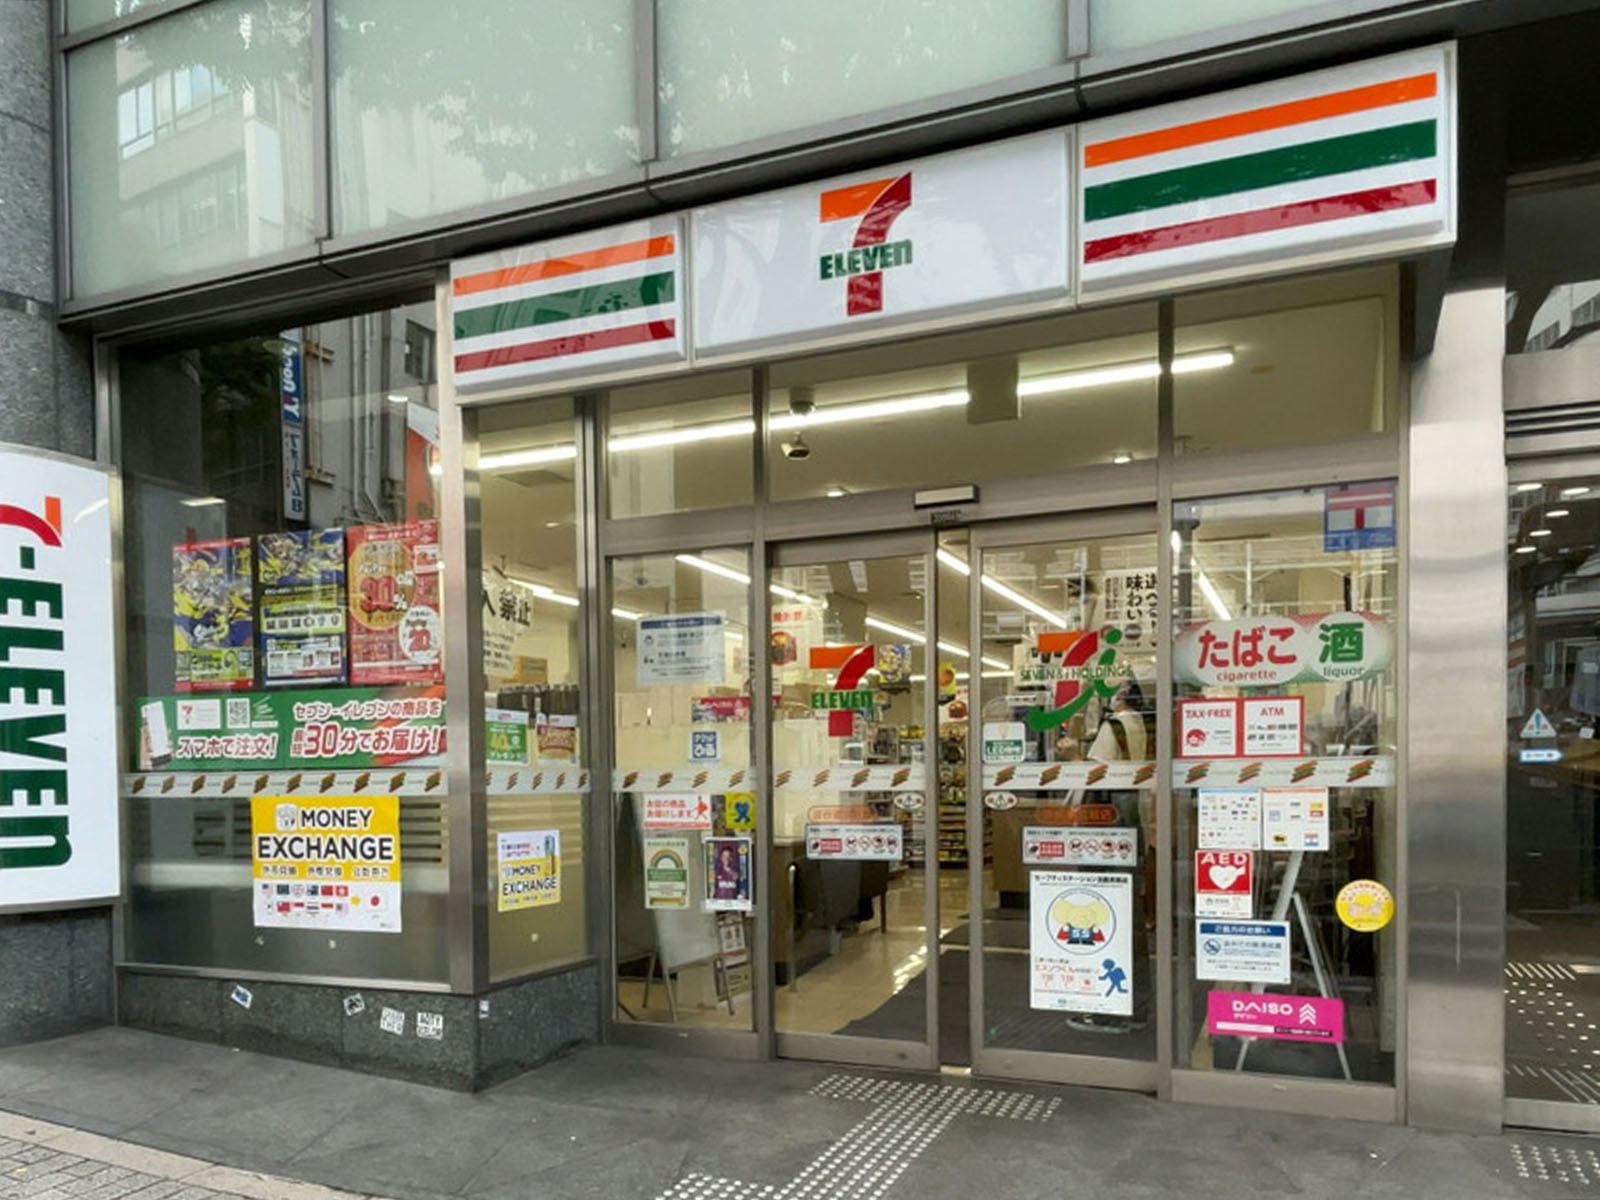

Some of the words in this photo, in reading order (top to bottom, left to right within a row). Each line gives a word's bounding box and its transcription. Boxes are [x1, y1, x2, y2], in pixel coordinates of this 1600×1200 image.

[1198, 625, 1297, 669] たばこ
[1319, 622, 1364, 663] 酒
[1217, 670, 1277, 682] cigarette
[1323, 666, 1364, 678] liquor
[1186, 709, 1232, 718] TAX-FREE
[1260, 707, 1285, 716] ATM
[178, 735, 276, 757] スマホで注文!
[301, 808, 372, 827] MONEY
[257, 836, 393, 860] EXCHANGE
[1201, 852, 1247, 865] AED
[512, 864, 541, 876] MONEY
[503, 877, 557, 896] EXCHANGE
[1232, 1000, 1294, 1016] DAISO
